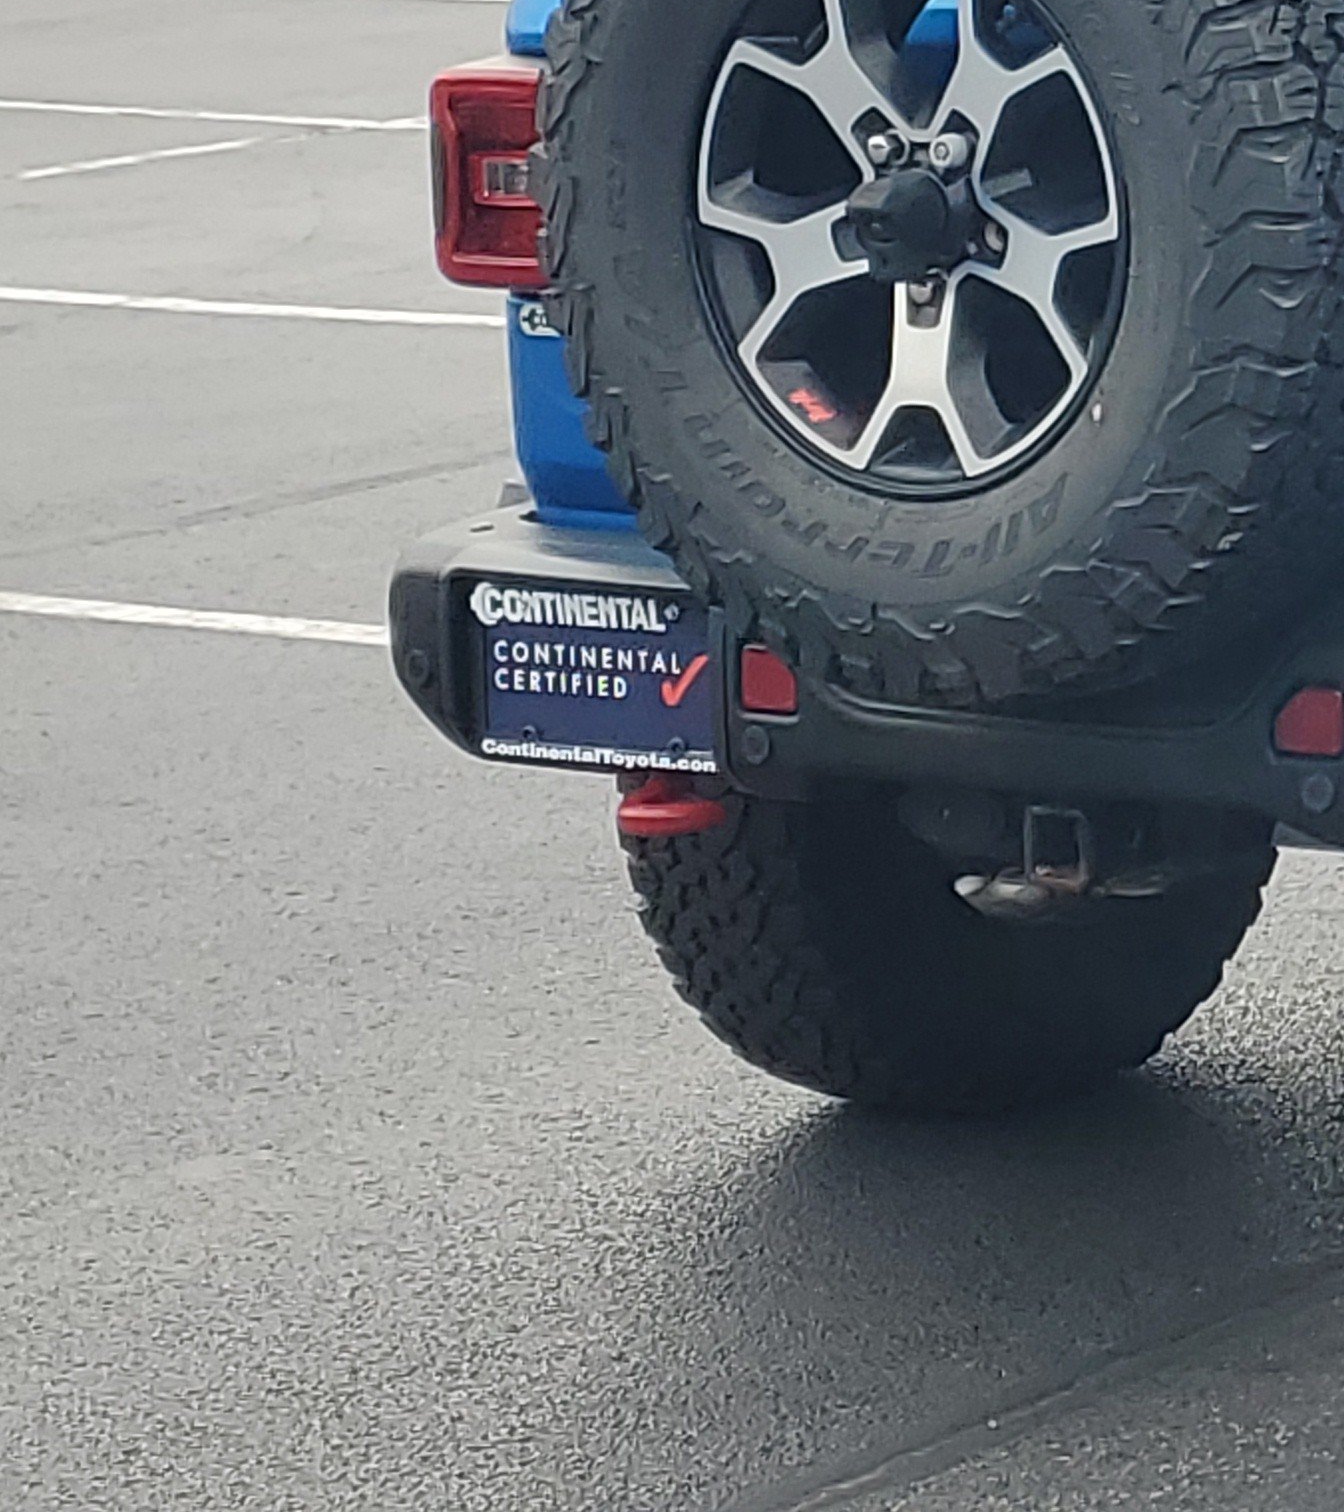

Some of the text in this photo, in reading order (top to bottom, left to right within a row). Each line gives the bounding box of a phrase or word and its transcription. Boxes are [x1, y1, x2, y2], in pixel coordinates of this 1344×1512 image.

[470, 582, 666, 633] CONTINENTAL
[493, 640, 681, 675] CONTINENTAL
[493, 668, 627, 699] CERTIFIED
